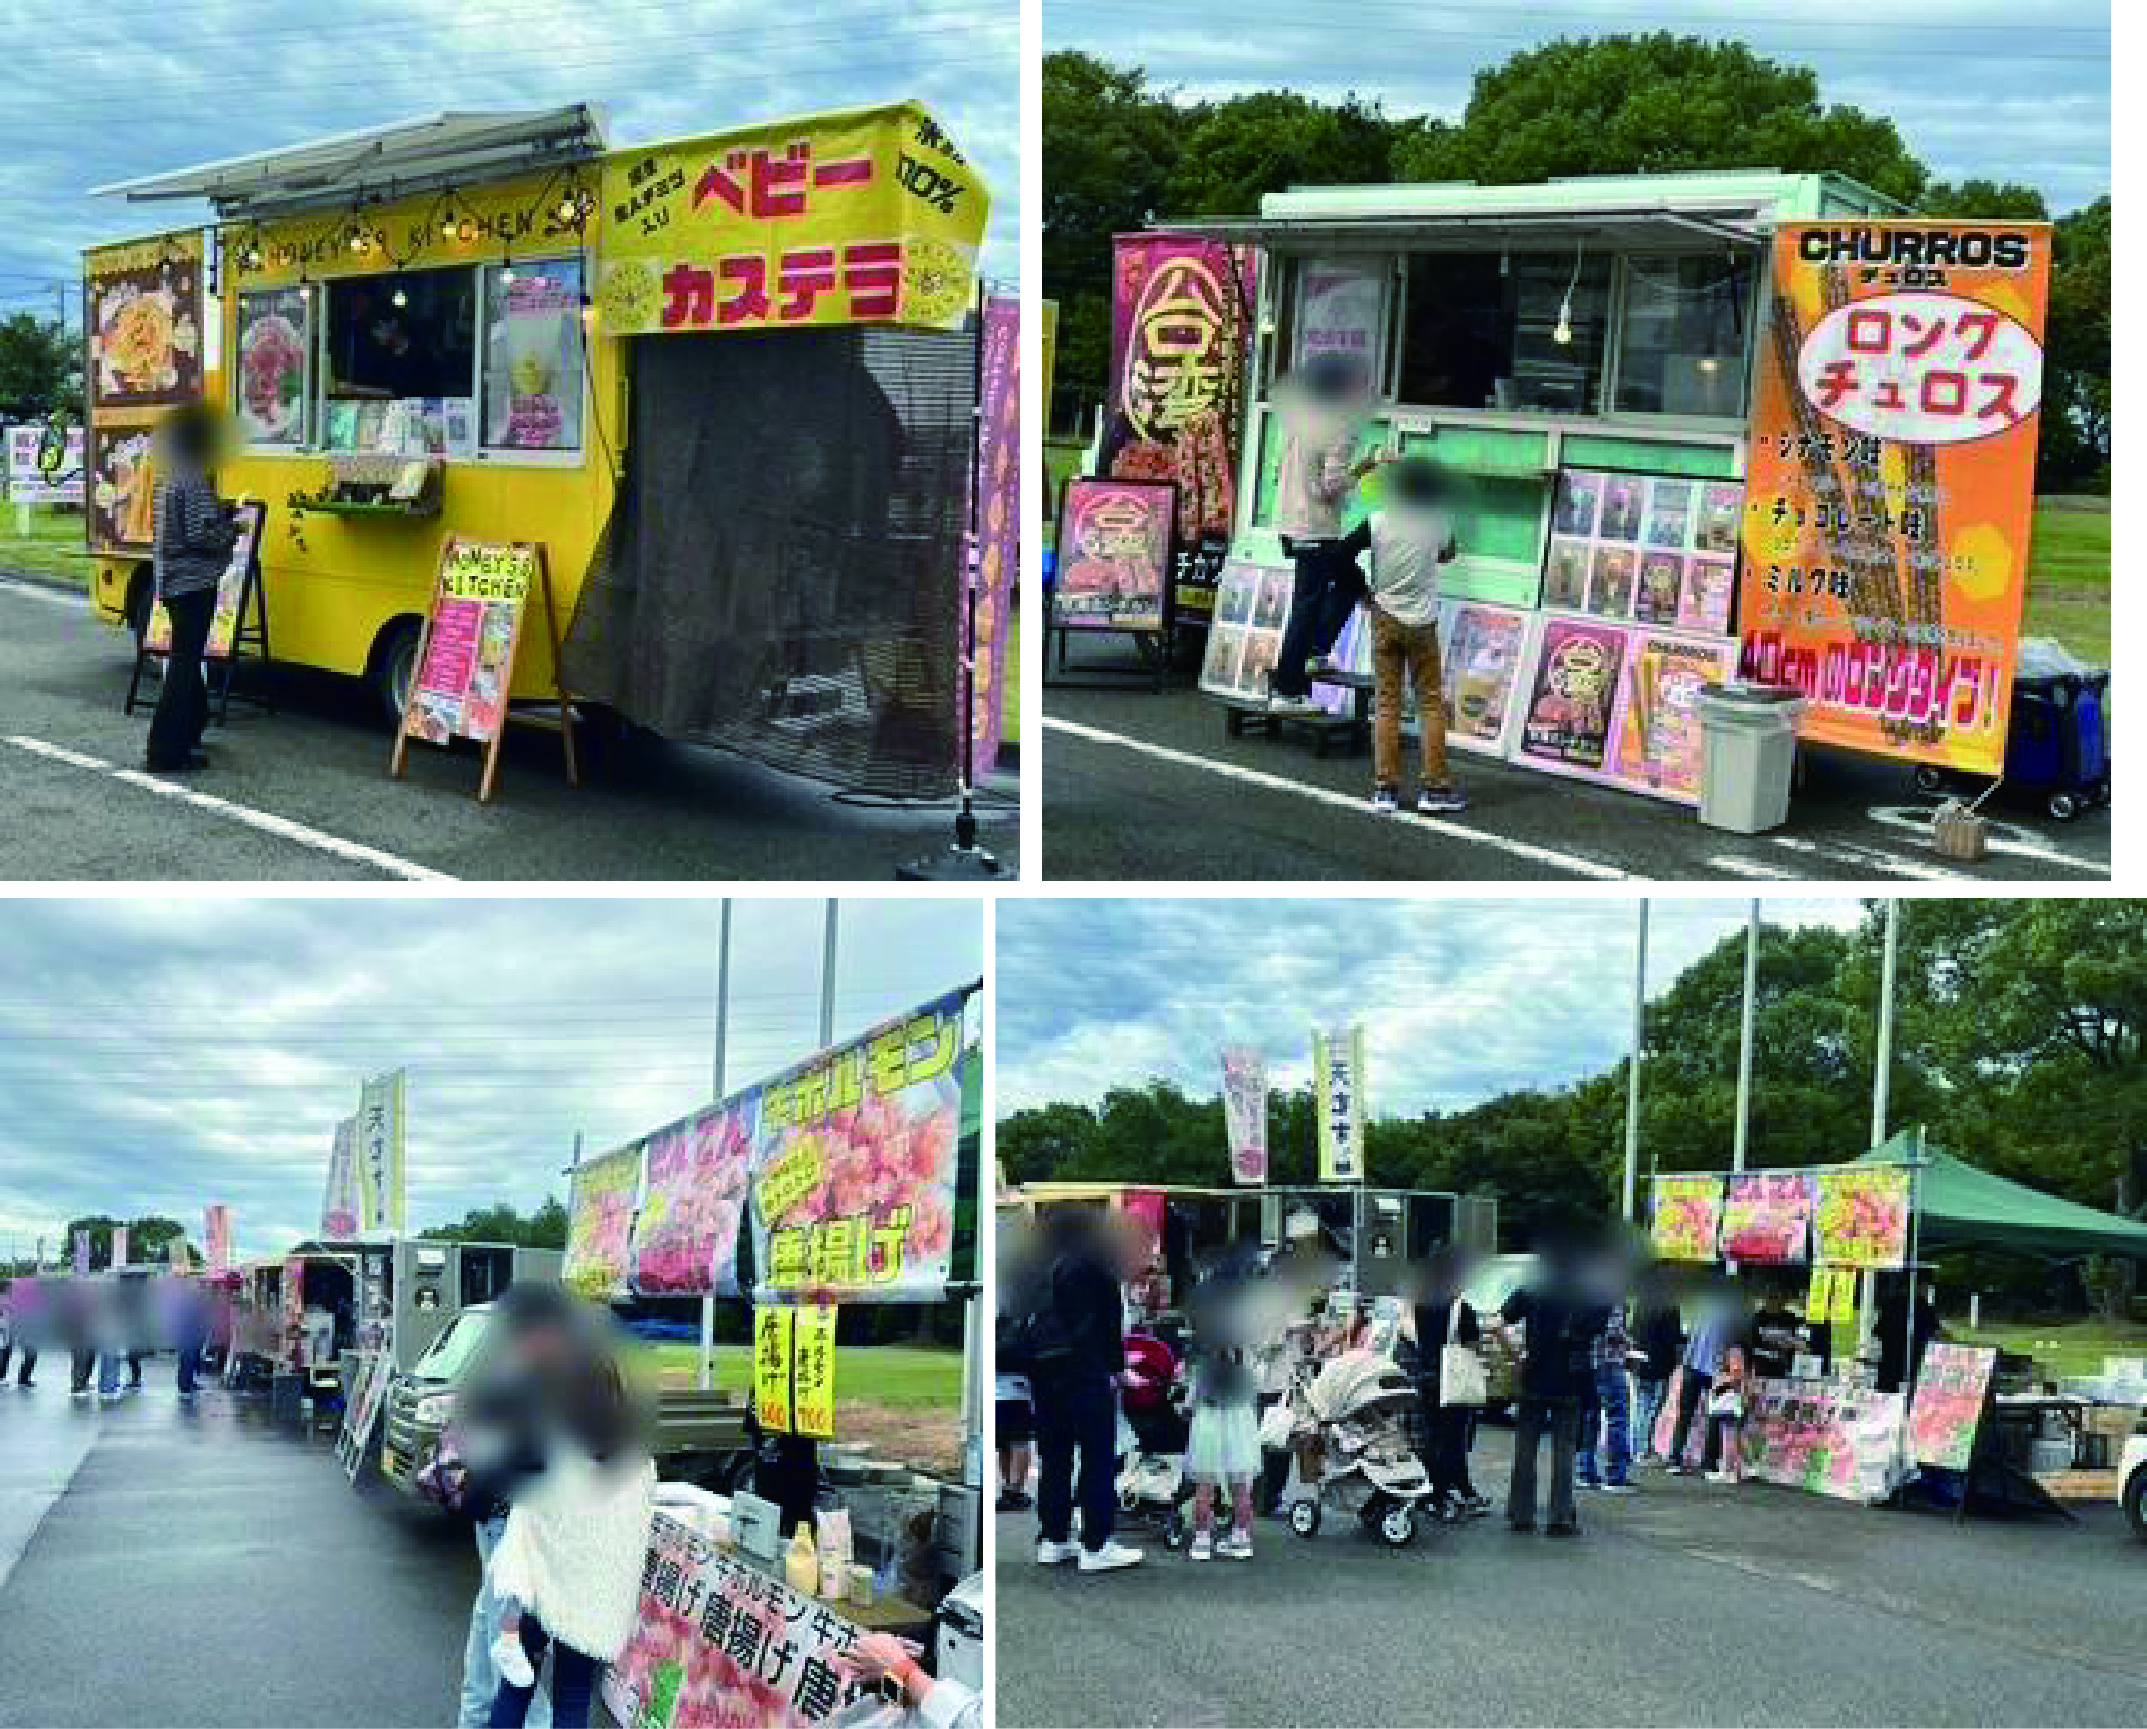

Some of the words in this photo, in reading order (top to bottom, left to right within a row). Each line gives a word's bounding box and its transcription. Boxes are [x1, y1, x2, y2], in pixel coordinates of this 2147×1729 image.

[692, 142, 872, 219] ベビー
[1799, 230, 2029, 268] CHURROS
[1860, 270, 1949, 288] チュロス
[662, 243, 902, 328] カステラ
[1131, 266, 1225, 434] 台湾
[1847, 311, 1999, 360] ロング
[1815, 360, 2026, 423] チュロス
[1778, 433, 1881, 463] シナモン味
[1771, 497, 1925, 541] チョコレート味
[1766, 564, 1851, 599] ミルク味
[763, 1014, 960, 1129] 牛ホルモン
[769, 1203, 914, 1288] 唐揚げ
[715, 1555, 806, 1622] 牛ホルモン
[700, 1592, 798, 1685] 唐揚げ
